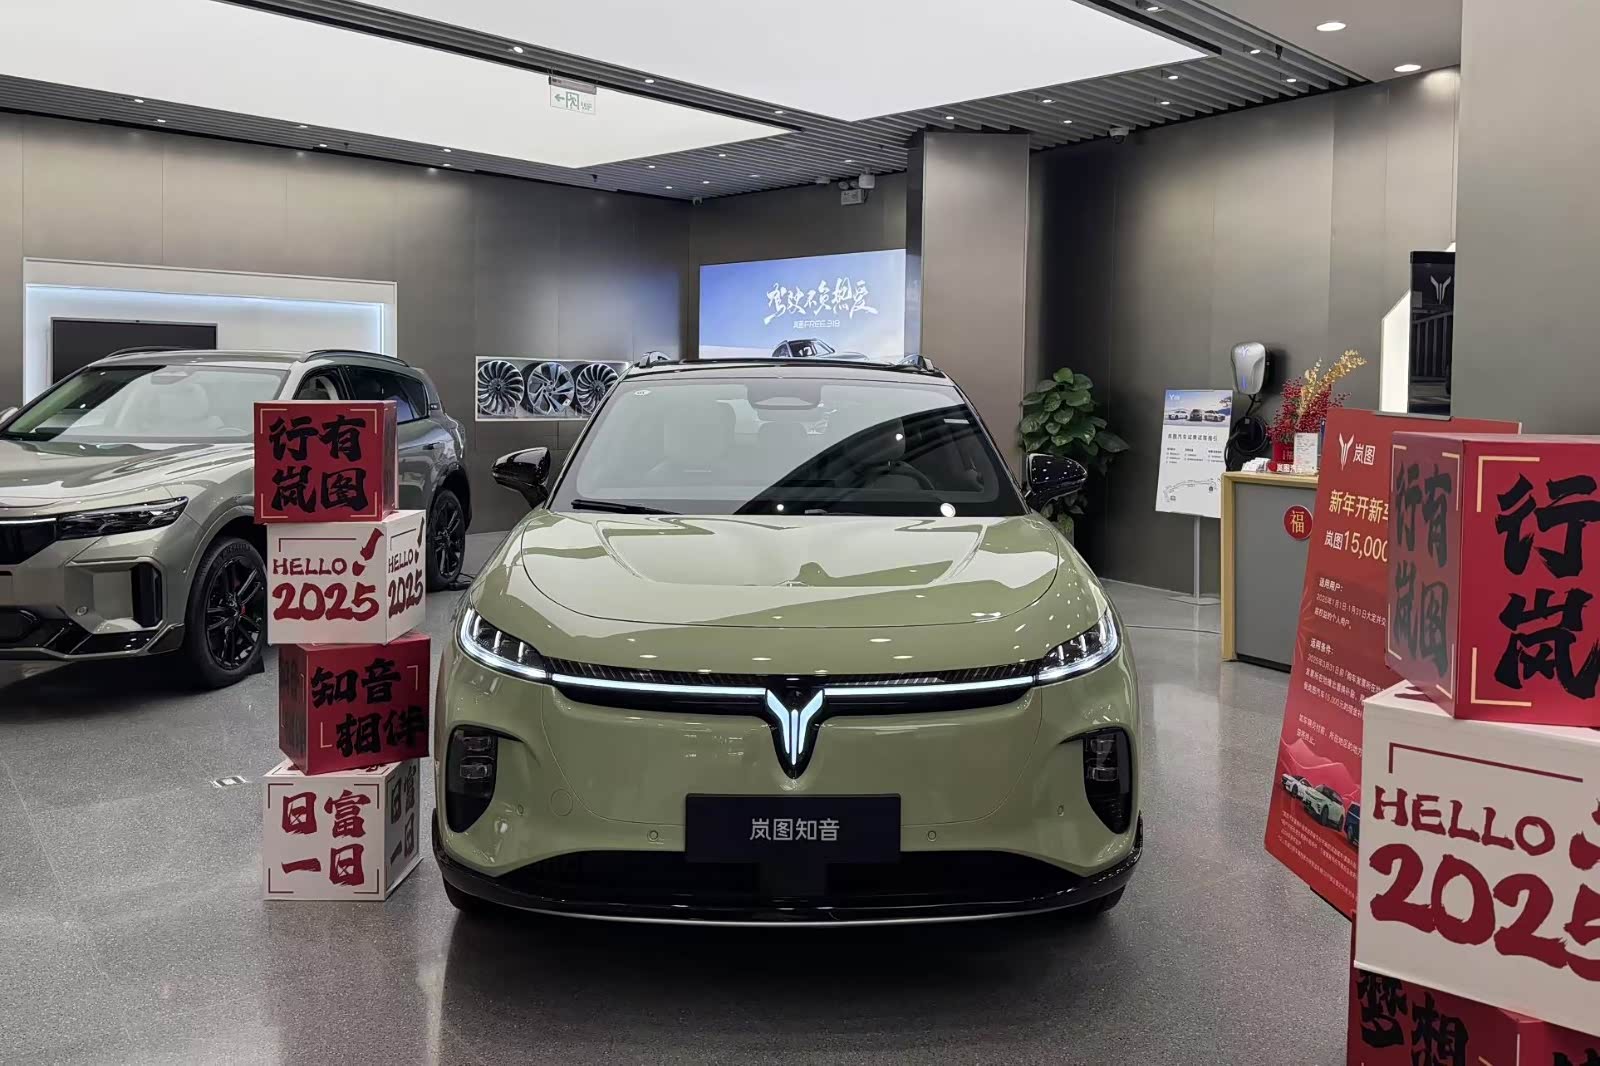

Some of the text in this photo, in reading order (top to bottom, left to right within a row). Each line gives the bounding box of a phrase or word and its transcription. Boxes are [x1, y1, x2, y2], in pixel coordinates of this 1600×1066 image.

[268, 414, 366, 462] 行有
[1353, 443, 1376, 466] 岚图
[271, 465, 369, 513] 岚图
[1290, 510, 1305, 535] 福
[1396, 462, 1452, 568] 行有
[272, 582, 380, 622] 2025
[388, 568, 424, 619] 2025
[311, 657, 401, 708] 知音
[282, 789, 371, 839] 日富
[750, 818, 840, 841] 岚图知音
[281, 843, 365, 886] 一日
